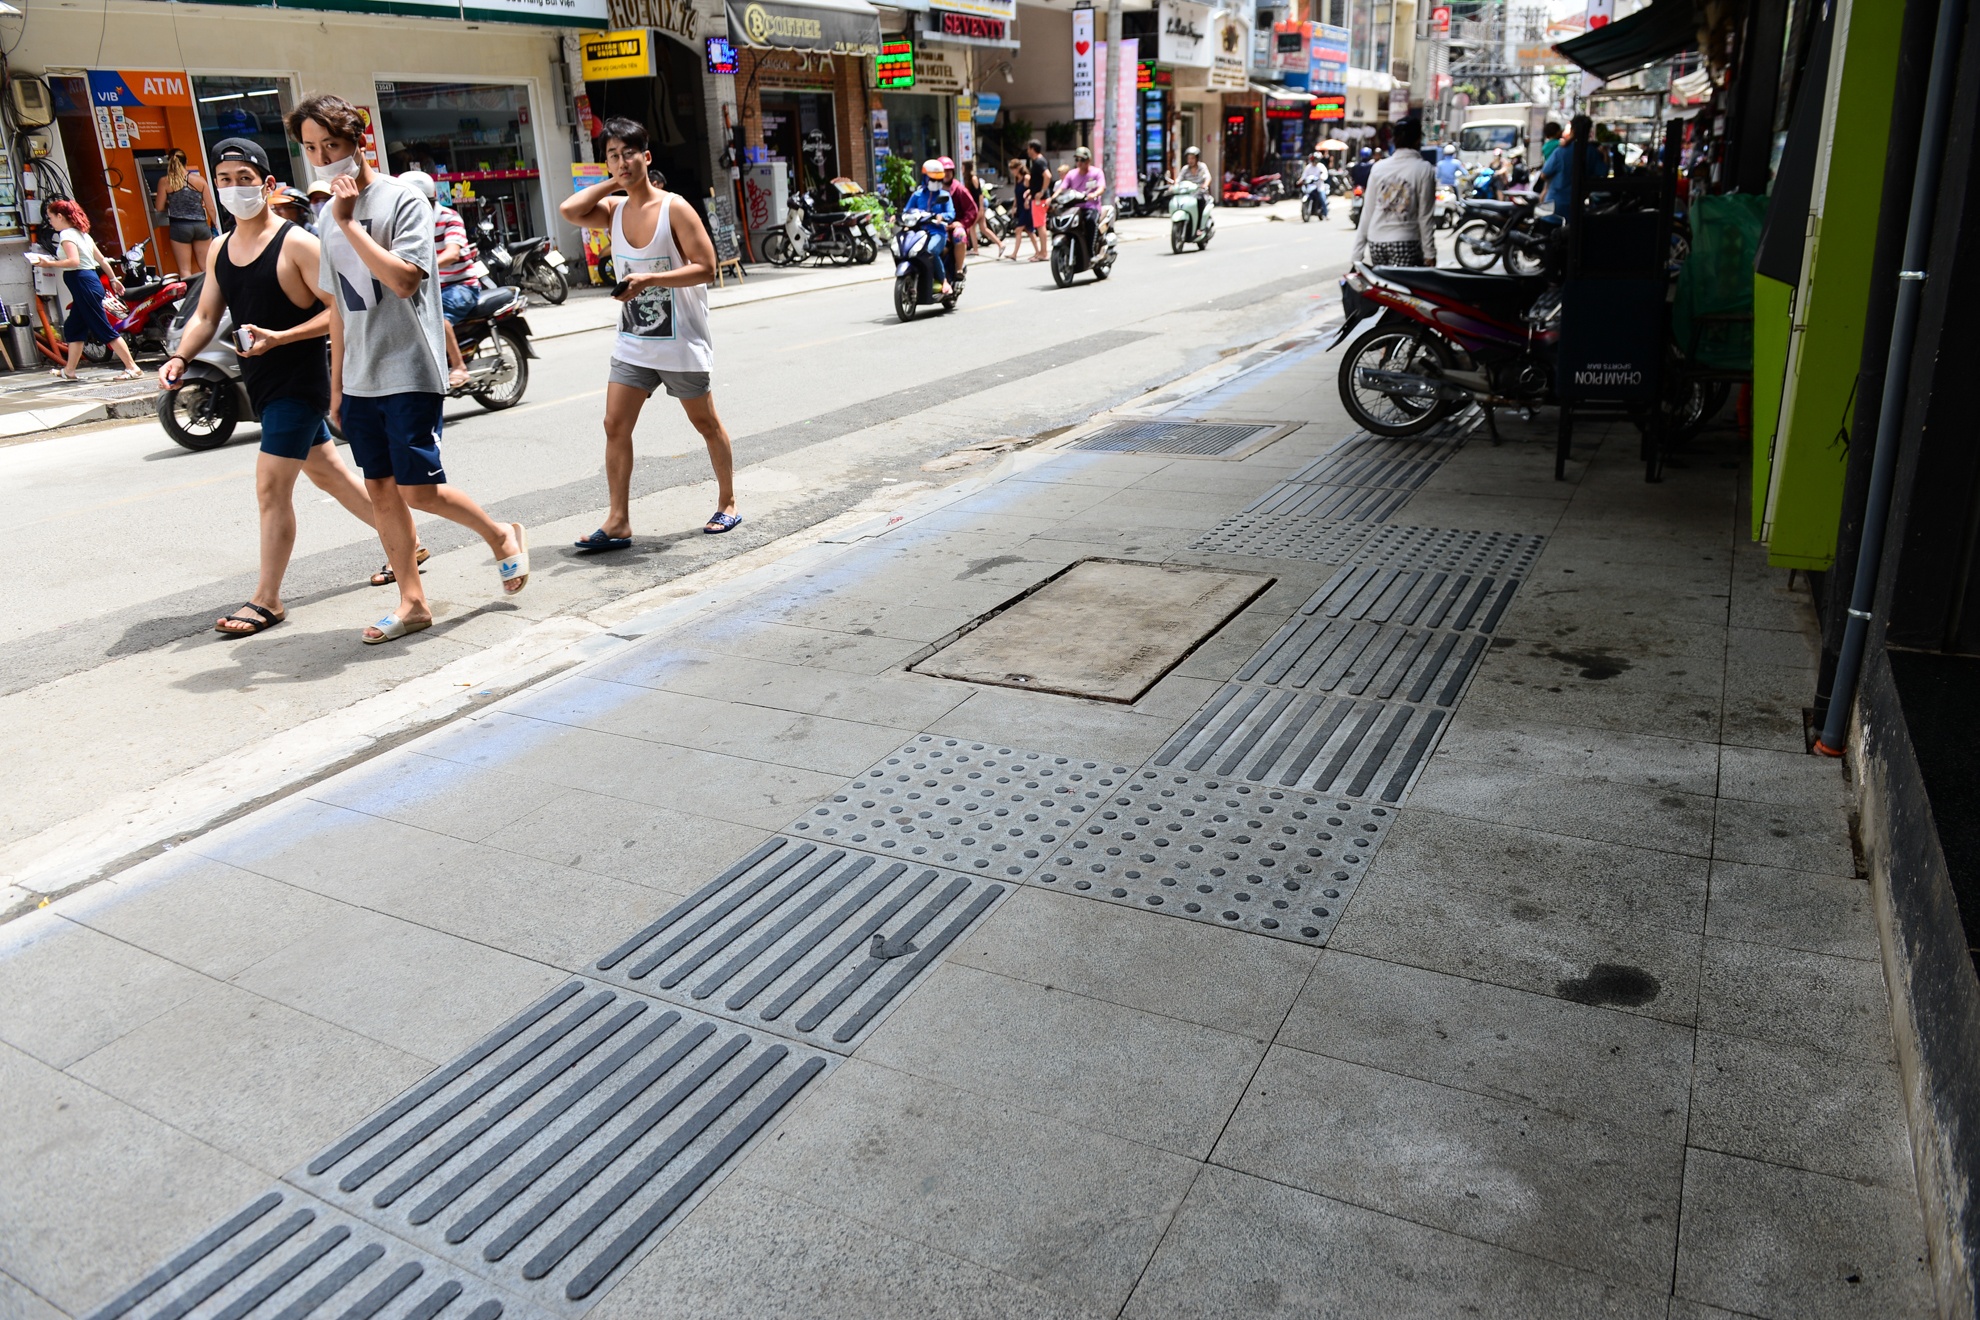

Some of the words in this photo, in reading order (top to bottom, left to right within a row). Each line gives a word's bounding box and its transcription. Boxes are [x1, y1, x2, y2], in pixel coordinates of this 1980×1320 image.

[608, 0, 679, 32] HOENIX
[944, 13, 1005, 39] SEVENTY
[588, 43, 618, 52] WESTERN
[597, 49, 618, 57] UNION
[762, 59, 790, 71] SAIGON
[926, 64, 956, 77] HOTEL
[97, 92, 119, 102] VIB
[143, 77, 185, 95] ATM
